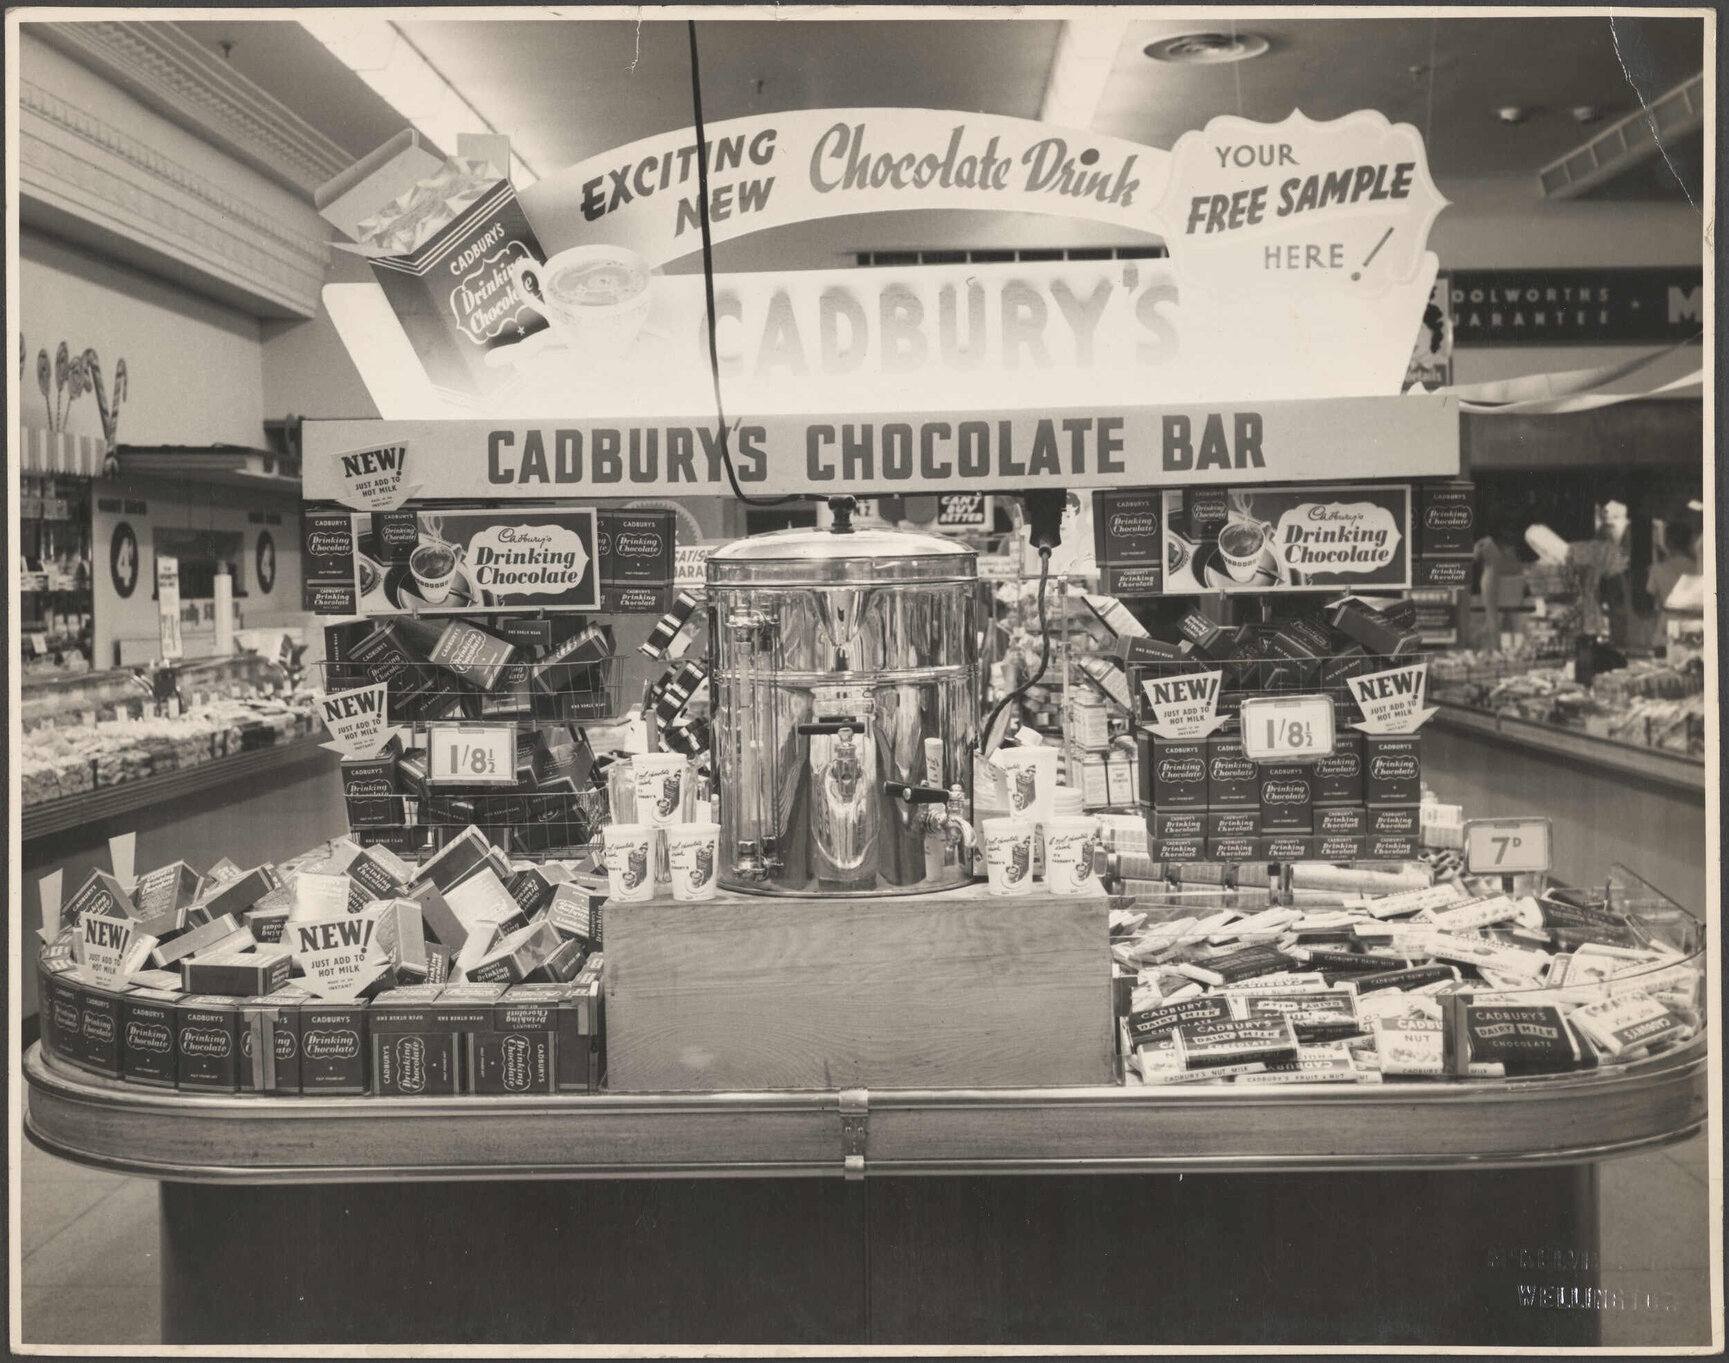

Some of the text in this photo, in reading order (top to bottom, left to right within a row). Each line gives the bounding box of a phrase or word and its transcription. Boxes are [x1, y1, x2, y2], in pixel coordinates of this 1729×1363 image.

[1215, 143, 1300, 169] YOUR
[809, 122, 1142, 208] Chocolate Drink
[580, 128, 778, 222] EXCITING
[1185, 162, 1416, 235] FREE SAMPLE
[674, 176, 776, 239] NEW
[462, 256, 522, 315] Drinkin
[1452, 288, 1610, 303] OOLWORTHS
[470, 276, 533, 334] Chocolae
[699, 263, 1180, 377] CADBURY'S
[1452, 311, 1609, 327] UARANTEE
[487, 412, 1267, 485] CADBURY'S CHOCOLATE BAR
[341, 447, 406, 478] NEW!
[356, 482, 372, 491] JUST
[374, 479, 389, 487] ADD
[362, 485, 398, 497] HOT MILK
[946, 504, 978, 514] BUY
[1307, 505, 1364, 526] Cadbury's
[1430, 510, 1468, 519] Drinking
[940, 513, 984, 523] BETTER
[1114, 517, 1153, 527] Drinking
[1428, 517, 1469, 525] Chocolate
[1113, 525, 1154, 533] Chocolate
[1283, 523, 1388, 547] Drinking
[312, 536, 350, 546] Drinking
[497, 527, 553, 549] Cadbury's
[620, 537, 658, 547] Drinking
[311, 544, 351, 552] Chocolate
[619, 544, 659, 553] Chocolate
[1284, 544, 1390, 564] Chocolate
[475, 546, 576, 569] Drinking
[476, 566, 578, 586] Chocolate
[452, 632, 478, 666] Drinking
[457, 635, 483, 672] Chocolate
[1152, 677, 1219, 707] NEW!
[1356, 670, 1424, 703] NEW!
[322, 689, 385, 722] NEW!
[1163, 710, 1180, 718] JUST
[1199, 706, 1210, 714] TO
[1370, 700, 1417, 715] JUST ADD TO
[1169, 714, 1206, 725] HOT MILK
[1376, 709, 1413, 722] HOT MILK
[337, 718, 381, 735] JUST ADD TO
[344, 727, 379, 741] HOT MILK
[1162, 763, 1201, 772] Drinking
[1214, 760, 1253, 770] Drinking
[1316, 764, 1357, 773] Chocolate
[1317, 757, 1356, 766] Drinking
[1375, 759, 1414, 768] Drinking
[1161, 770, 1202, 779] Chocolate
[1213, 768, 1254, 777] Chocolate
[1374, 767, 1416, 776] Chocolate
[350, 784, 387, 793] Drinking
[1266, 784, 1305, 794] Drinking
[1265, 792, 1306, 800] Chocolate
[356, 866, 387, 892] Chocolate
[361, 862, 392, 890] Drinking
[85, 918, 130, 960] NEW!
[297, 919, 375, 954] NEW!
[88, 953, 100, 962] JUST
[102, 955, 113, 964] ADD
[311, 953, 365, 969] JUST ADD TO
[91, 963, 116, 975] HOT MILK
[318, 964, 360, 978] HOT MILK
[476, 966, 509, 982] Drinking
[505, 1015, 547, 1024] Drinking
[506, 1009, 548, 1017] Chocolate
[1140, 1009, 1217, 1031] DAIRY MILK
[84, 1013, 112, 1030] Drinking
[1151, 1018, 1213, 1035] CHOLATE
[1397, 1019, 1443, 1031] CADBU
[83, 1023, 112, 1037] Chocolate
[129, 1025, 168, 1041] Drinking
[1479, 1024, 1556, 1038] DAIRY MILK
[128, 1034, 168, 1049] Chocolate
[184, 1032, 226, 1046] Drinking
[308, 1035, 354, 1046] Drinking
[1196, 1032, 1232, 1044] DAIRY
[1404, 1034, 1430, 1043] NUT
[1491, 1040, 1552, 1049] CHOCOLATE
[183, 1042, 227, 1053] Chocolate
[306, 1044, 355, 1054] Chocolate
[402, 1041, 412, 1090] Drinking
[410, 1040, 420, 1090] Chocolate
[507, 1038, 517, 1088] Chocolate
[515, 1039, 526, 1087] Drinking
[1211, 1069, 1226, 1077] NUT
[1231, 1065, 1248, 1073] MILK
